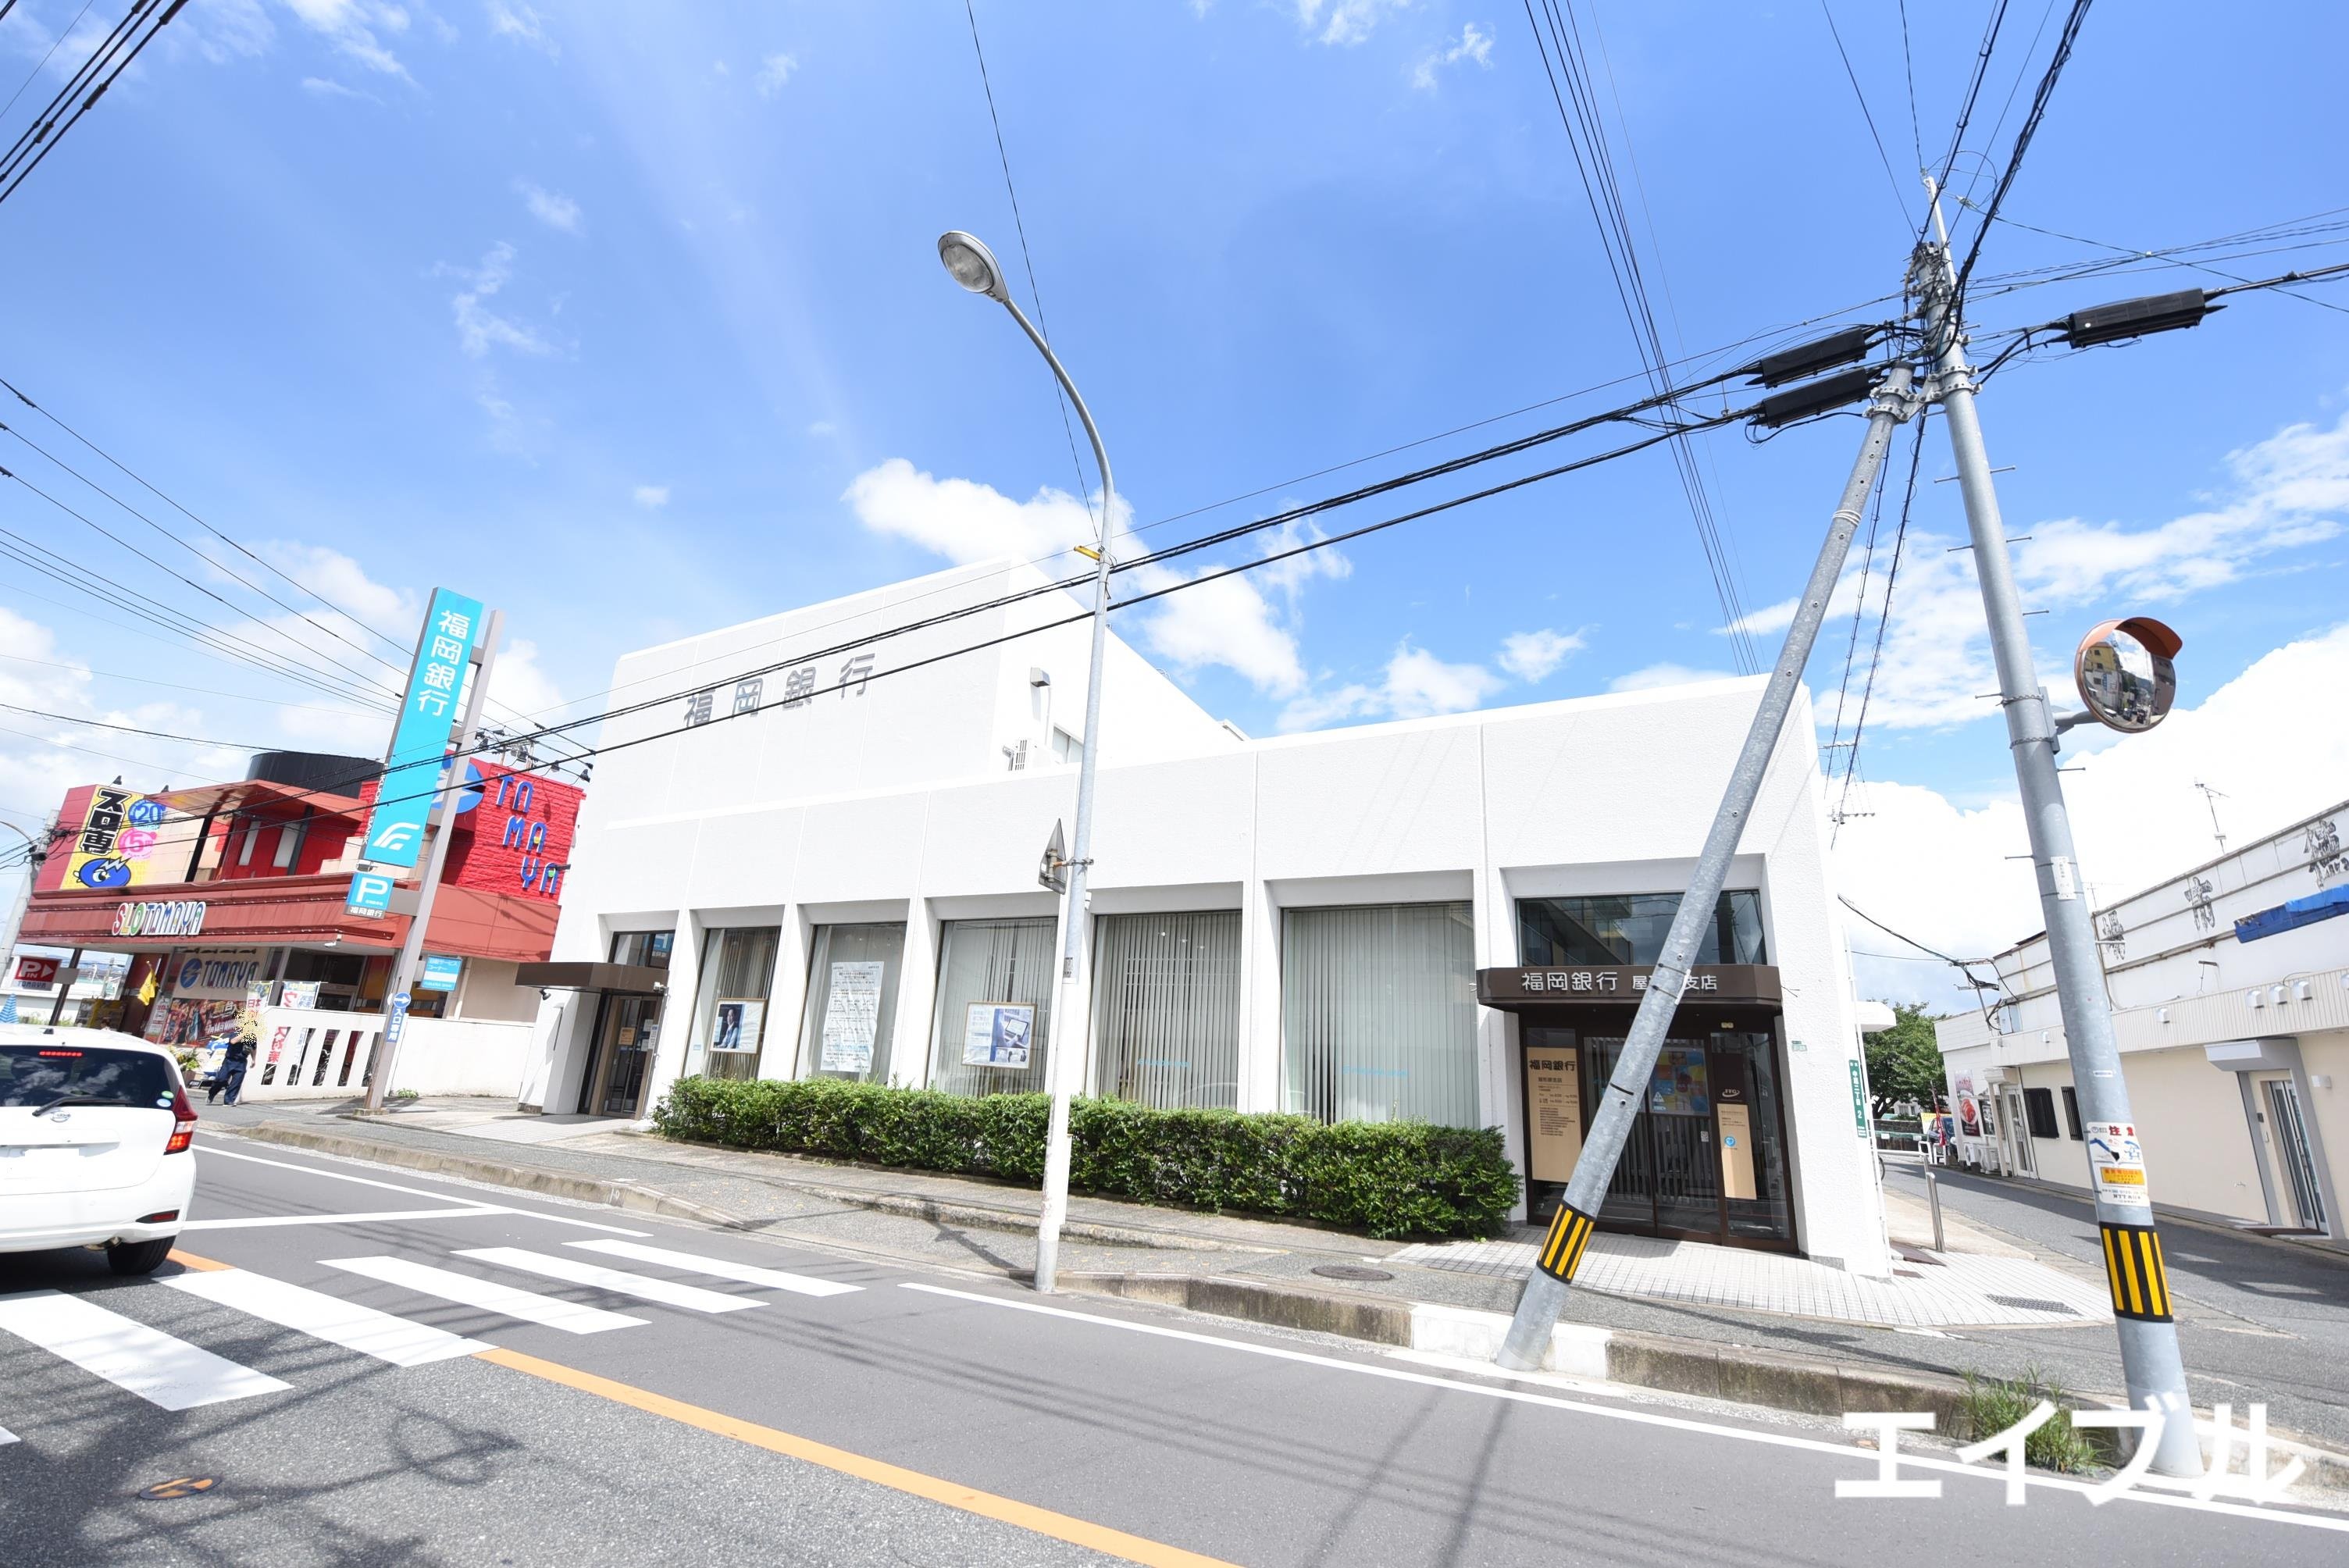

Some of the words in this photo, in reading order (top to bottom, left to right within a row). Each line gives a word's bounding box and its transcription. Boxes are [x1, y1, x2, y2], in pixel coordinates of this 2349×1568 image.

[417, 609, 471, 717] 福岡銀行
[684, 654, 875, 728] 福岡銀行
[362, 816, 375, 844] BANK
[503, 815, 547, 854] MA
[355, 877, 389, 903] P
[350, 906, 383, 918] 福岡銀行
[20, 961, 41, 977] P
[1521, 972, 1618, 991] 福岡銀行
[1632, 975, 1718, 990] 屋支店
[387, 1008, 404, 1041] 入口専用
[1529, 1060, 1576, 1071] 福岡銀行
[1857, 1110, 1862, 1119] 2
